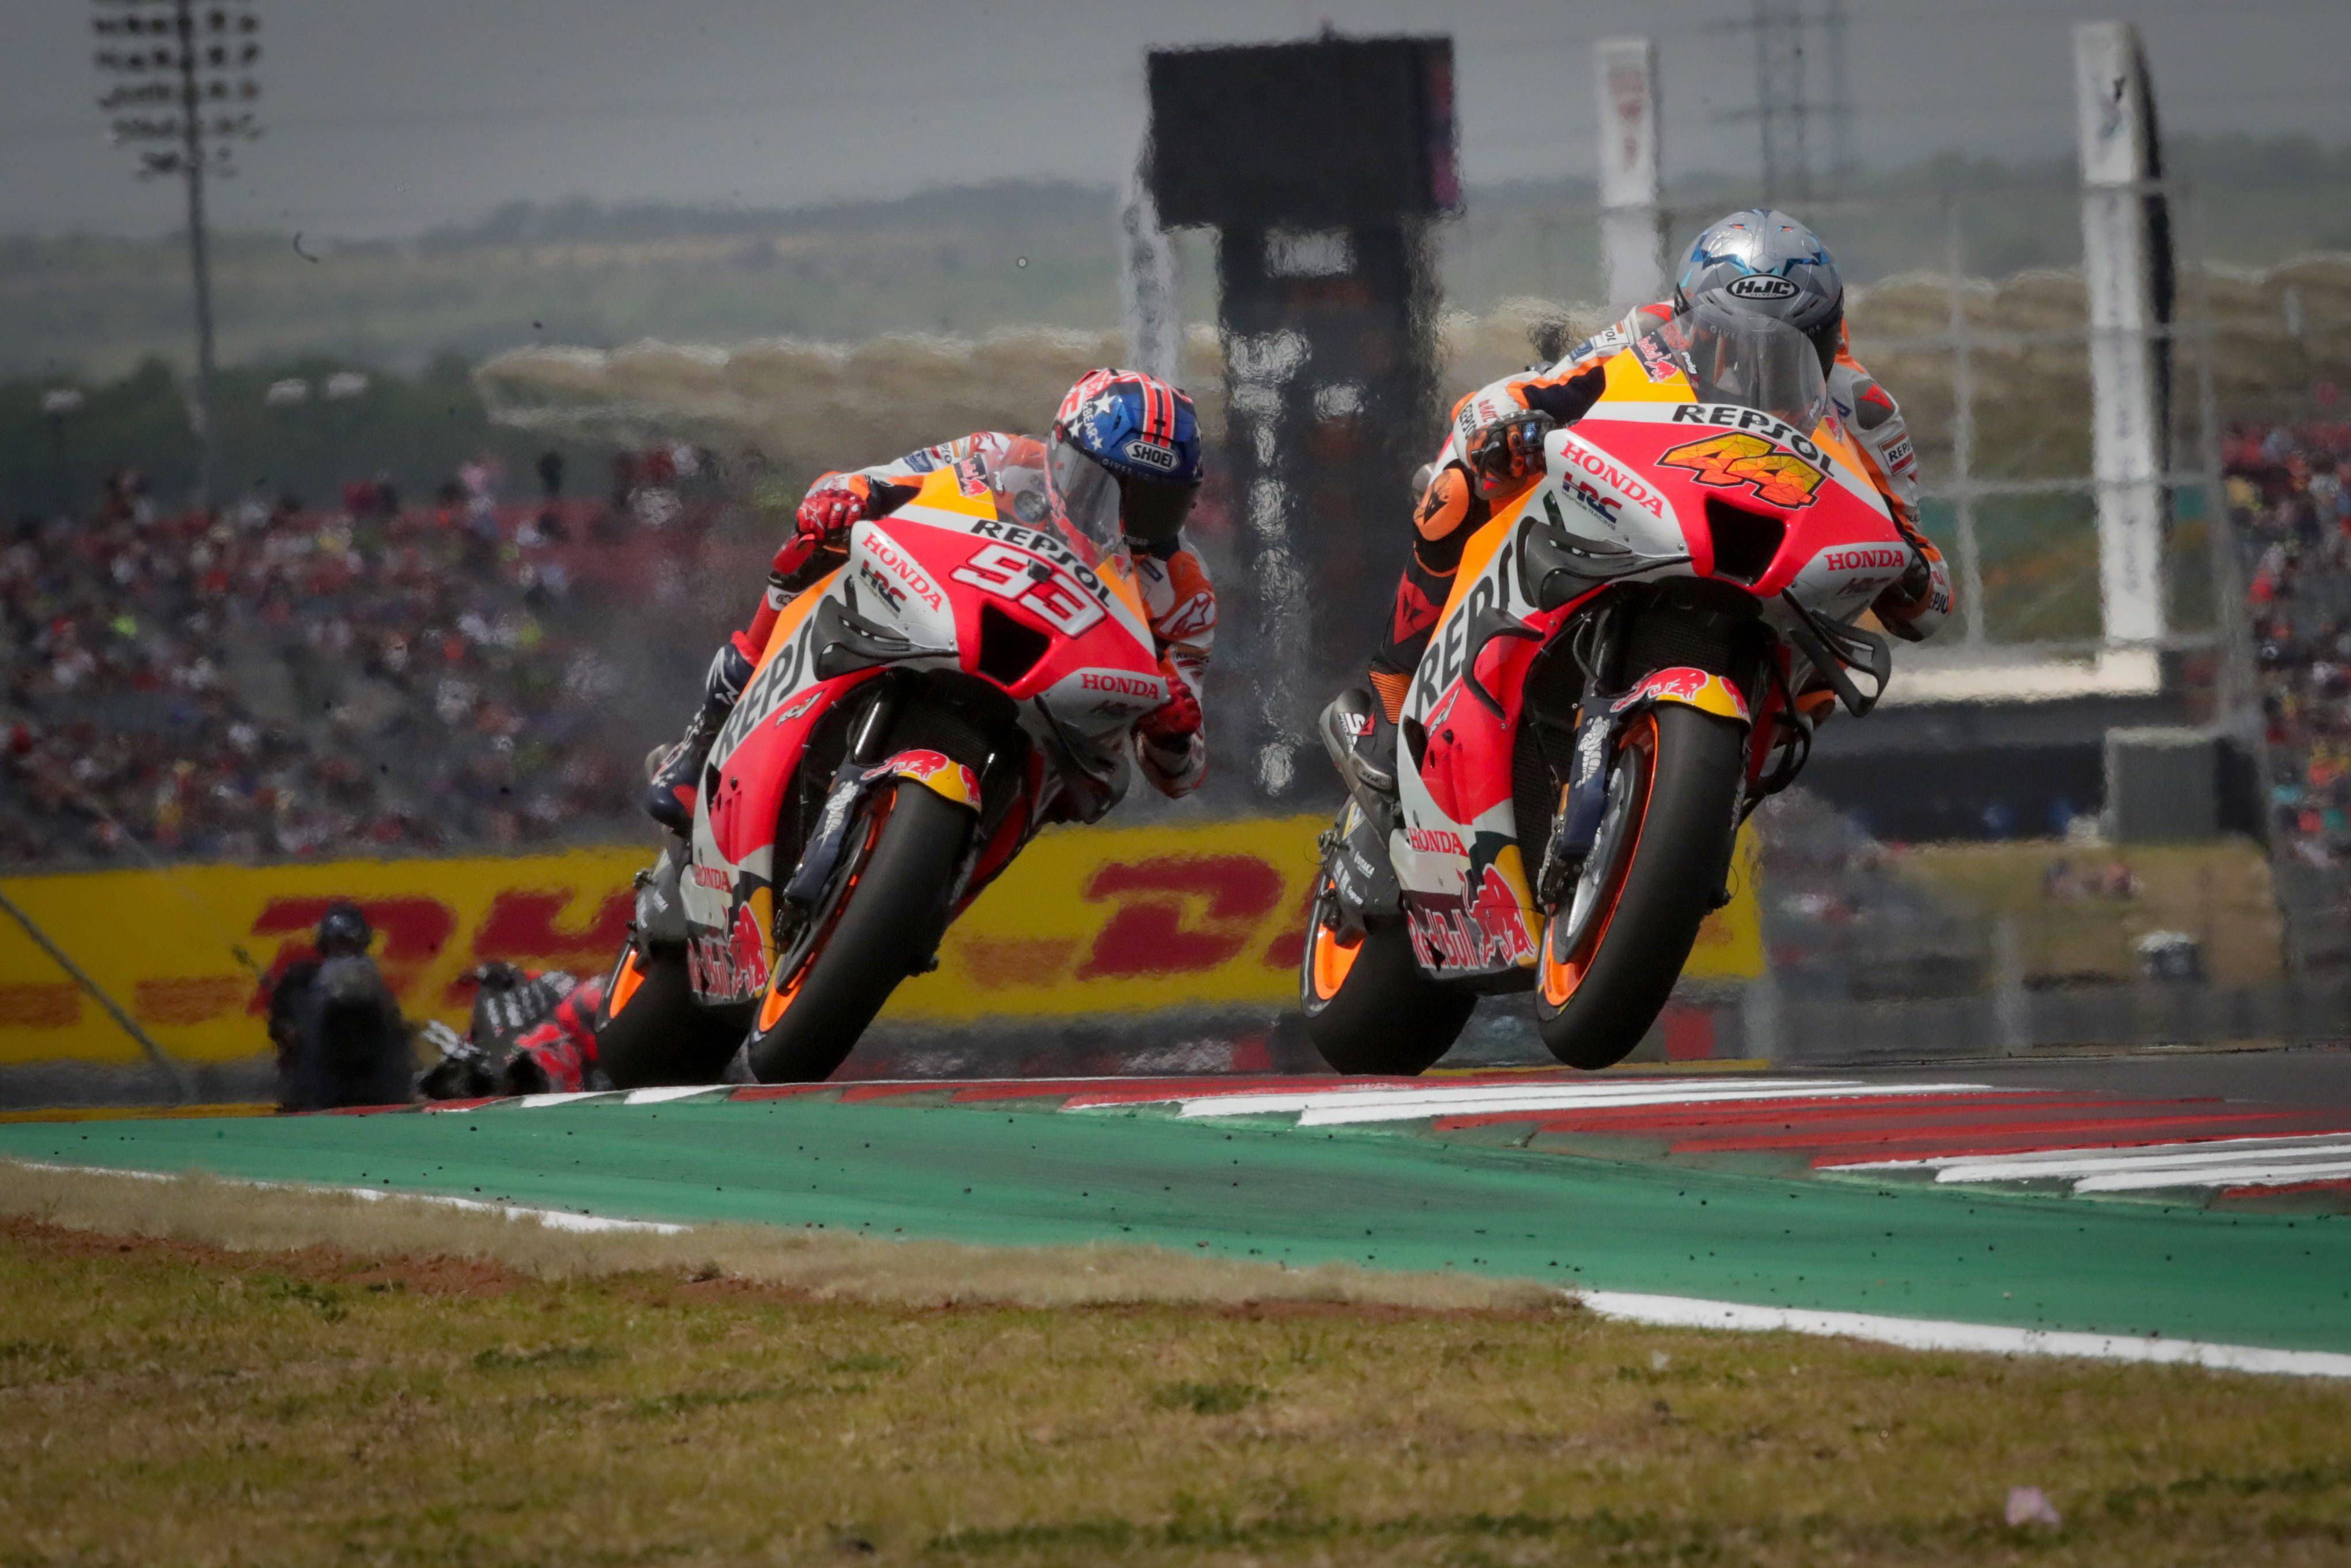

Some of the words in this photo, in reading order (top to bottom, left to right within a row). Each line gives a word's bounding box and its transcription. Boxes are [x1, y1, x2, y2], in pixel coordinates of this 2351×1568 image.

[1736, 280, 1791, 295] HJC
[1681, 352, 1698, 375] Puig
[1131, 444, 1173, 468] SHOEI
[1672, 404, 1835, 478] REPSOL
[1560, 440, 1664, 519] HONDA
[1657, 430, 1827, 510] 44
[1562, 471, 1623, 524] HRC
[860, 558, 908, 614] HRC
[861, 531, 943, 613] HONDA
[970, 519, 1110, 609] REPSOL
[1824, 550, 1905, 571] HONDA
[948, 542, 1108, 640] 93
[1080, 673, 1159, 700] HONDA
[1407, 827, 1470, 858] HONDA
[693, 864, 733, 894] HONDA
